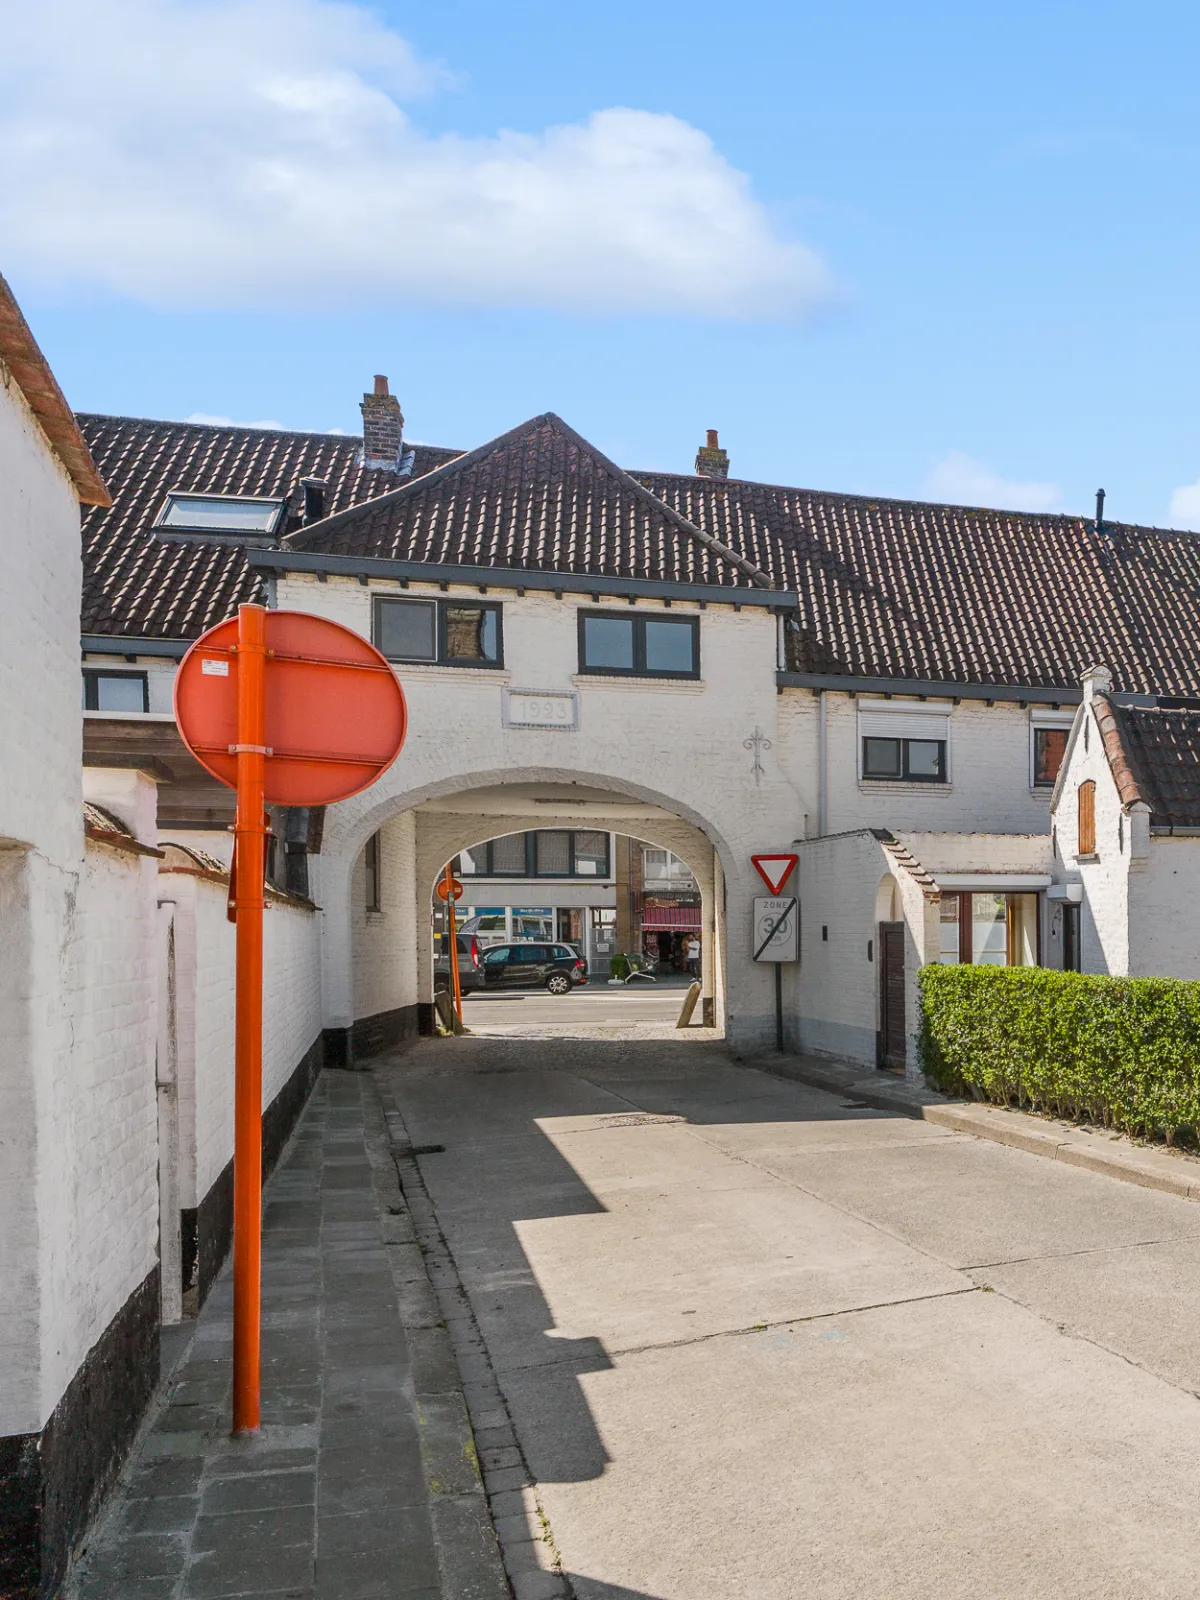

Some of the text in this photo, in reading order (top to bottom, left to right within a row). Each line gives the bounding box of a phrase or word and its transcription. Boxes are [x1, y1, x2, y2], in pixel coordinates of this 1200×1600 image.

[520, 699, 567, 720] 1923
[763, 901, 787, 909] ZONE
[763, 917, 788, 933] 30
